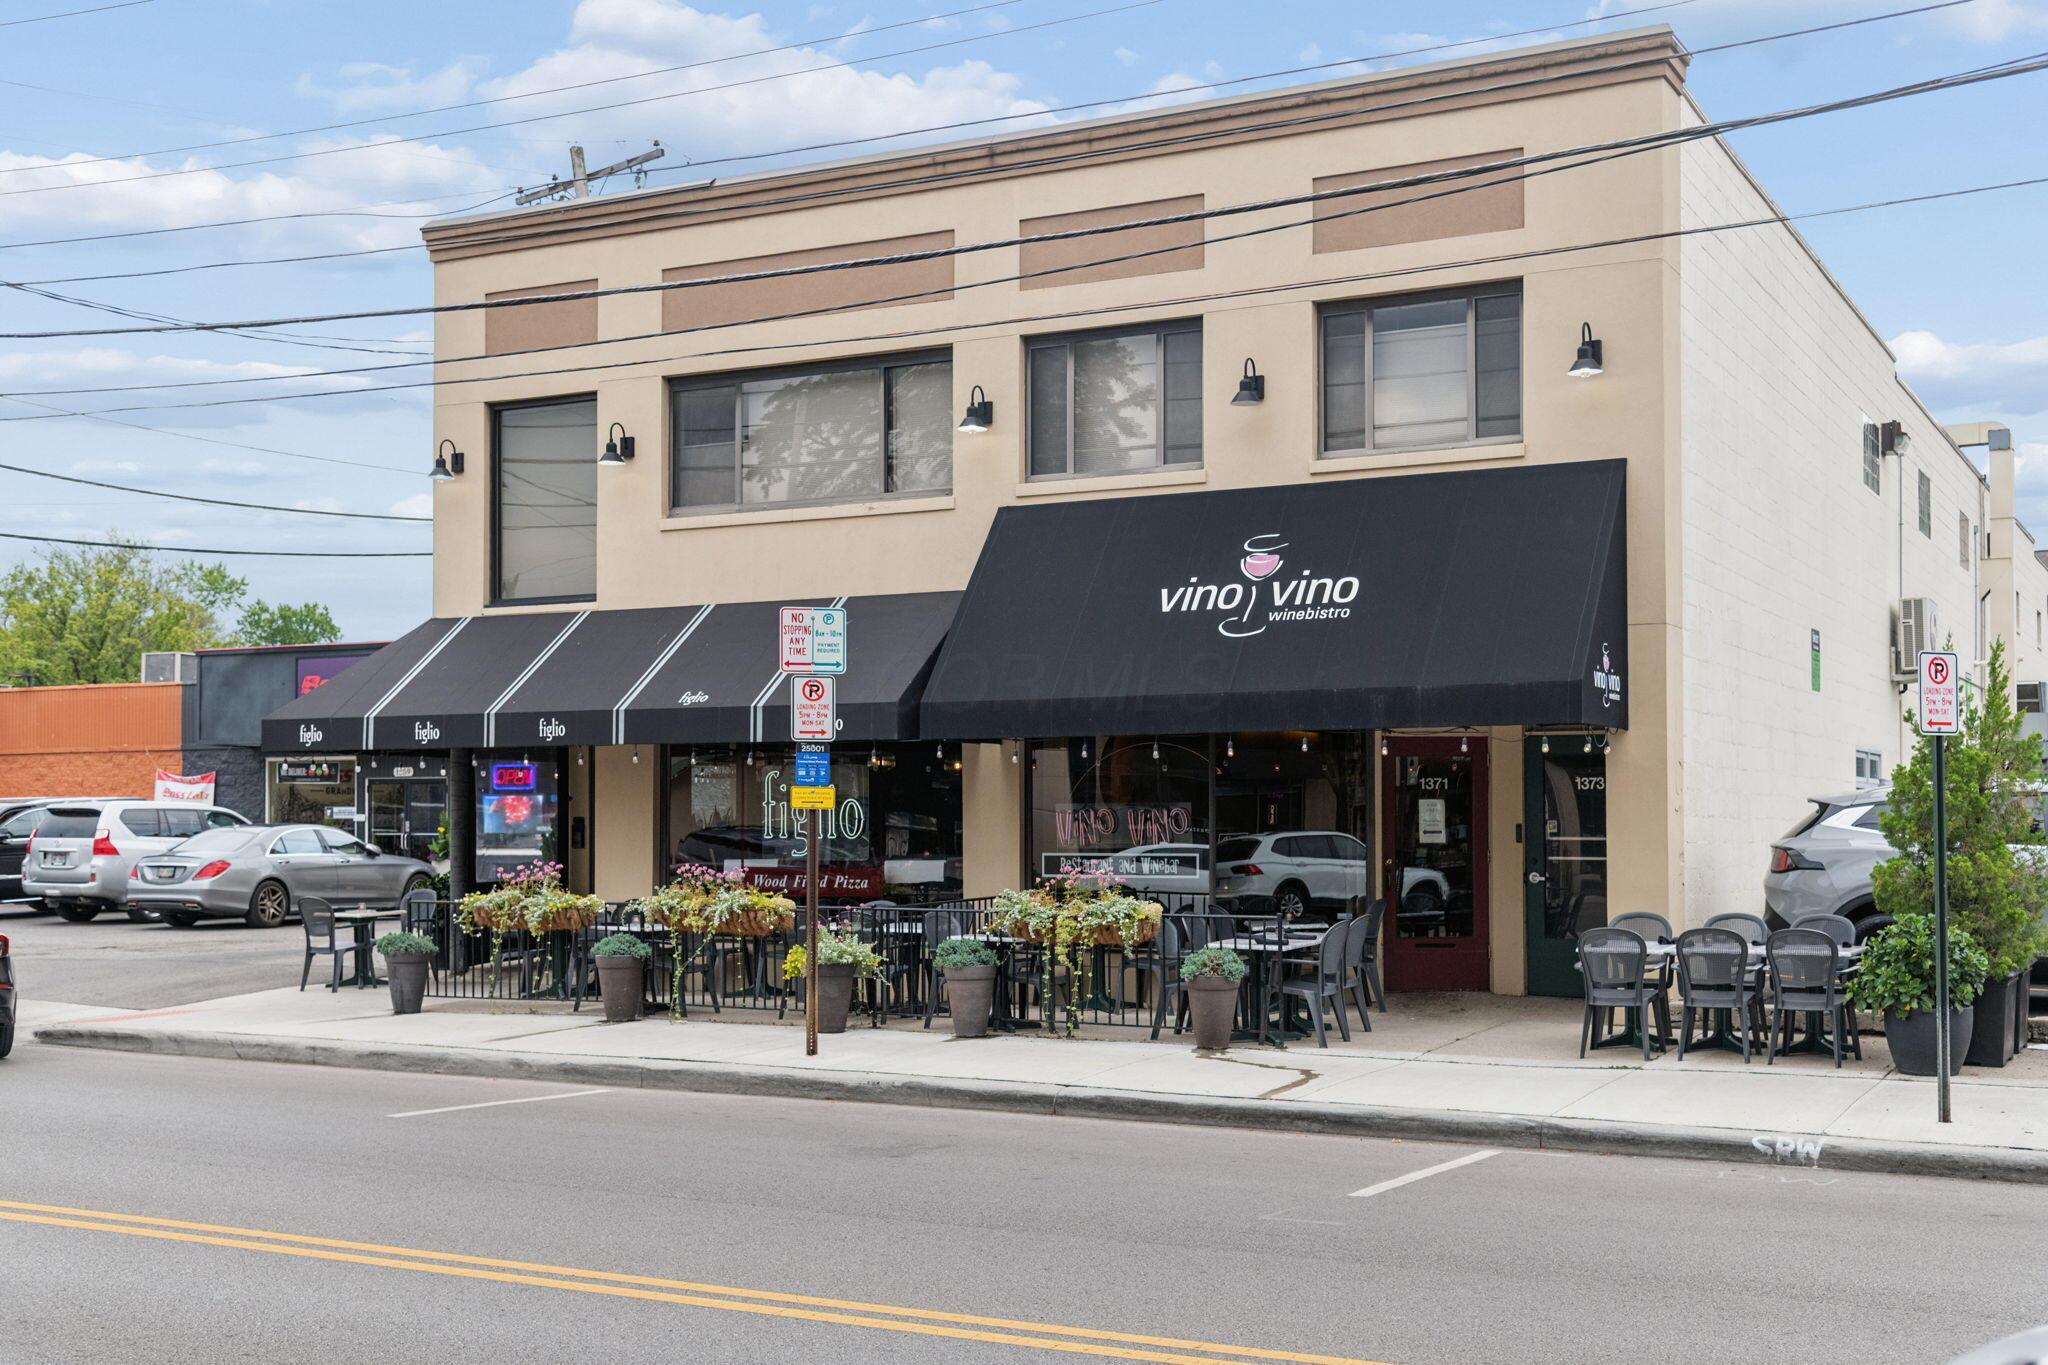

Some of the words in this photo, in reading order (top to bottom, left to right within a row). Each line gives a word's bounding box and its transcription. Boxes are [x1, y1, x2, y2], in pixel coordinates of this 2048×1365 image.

[1161, 577, 1244, 612] vino
[1272, 570, 1360, 607] vino
[791, 613, 804, 623] NO
[1268, 606, 1350, 622] winebistro
[783, 625, 812, 636] STOPPING
[789, 637, 806, 646] ANY
[788, 647, 807, 656] TIME
[678, 691, 709, 706] figlio
[1942, 688, 1954, 696] ZONE
[299, 724, 323, 747] figlio
[414, 721, 440, 745] figlio
[539, 718, 566, 742] figlio
[495, 769, 533, 785] OPEN
[1419, 777, 1448, 790] 1371
[1575, 777, 1605, 790] 1373
[754, 874, 788, 888] Wood
[793, 875, 828, 888] Fid
[834, 875, 869, 888] Pizza
